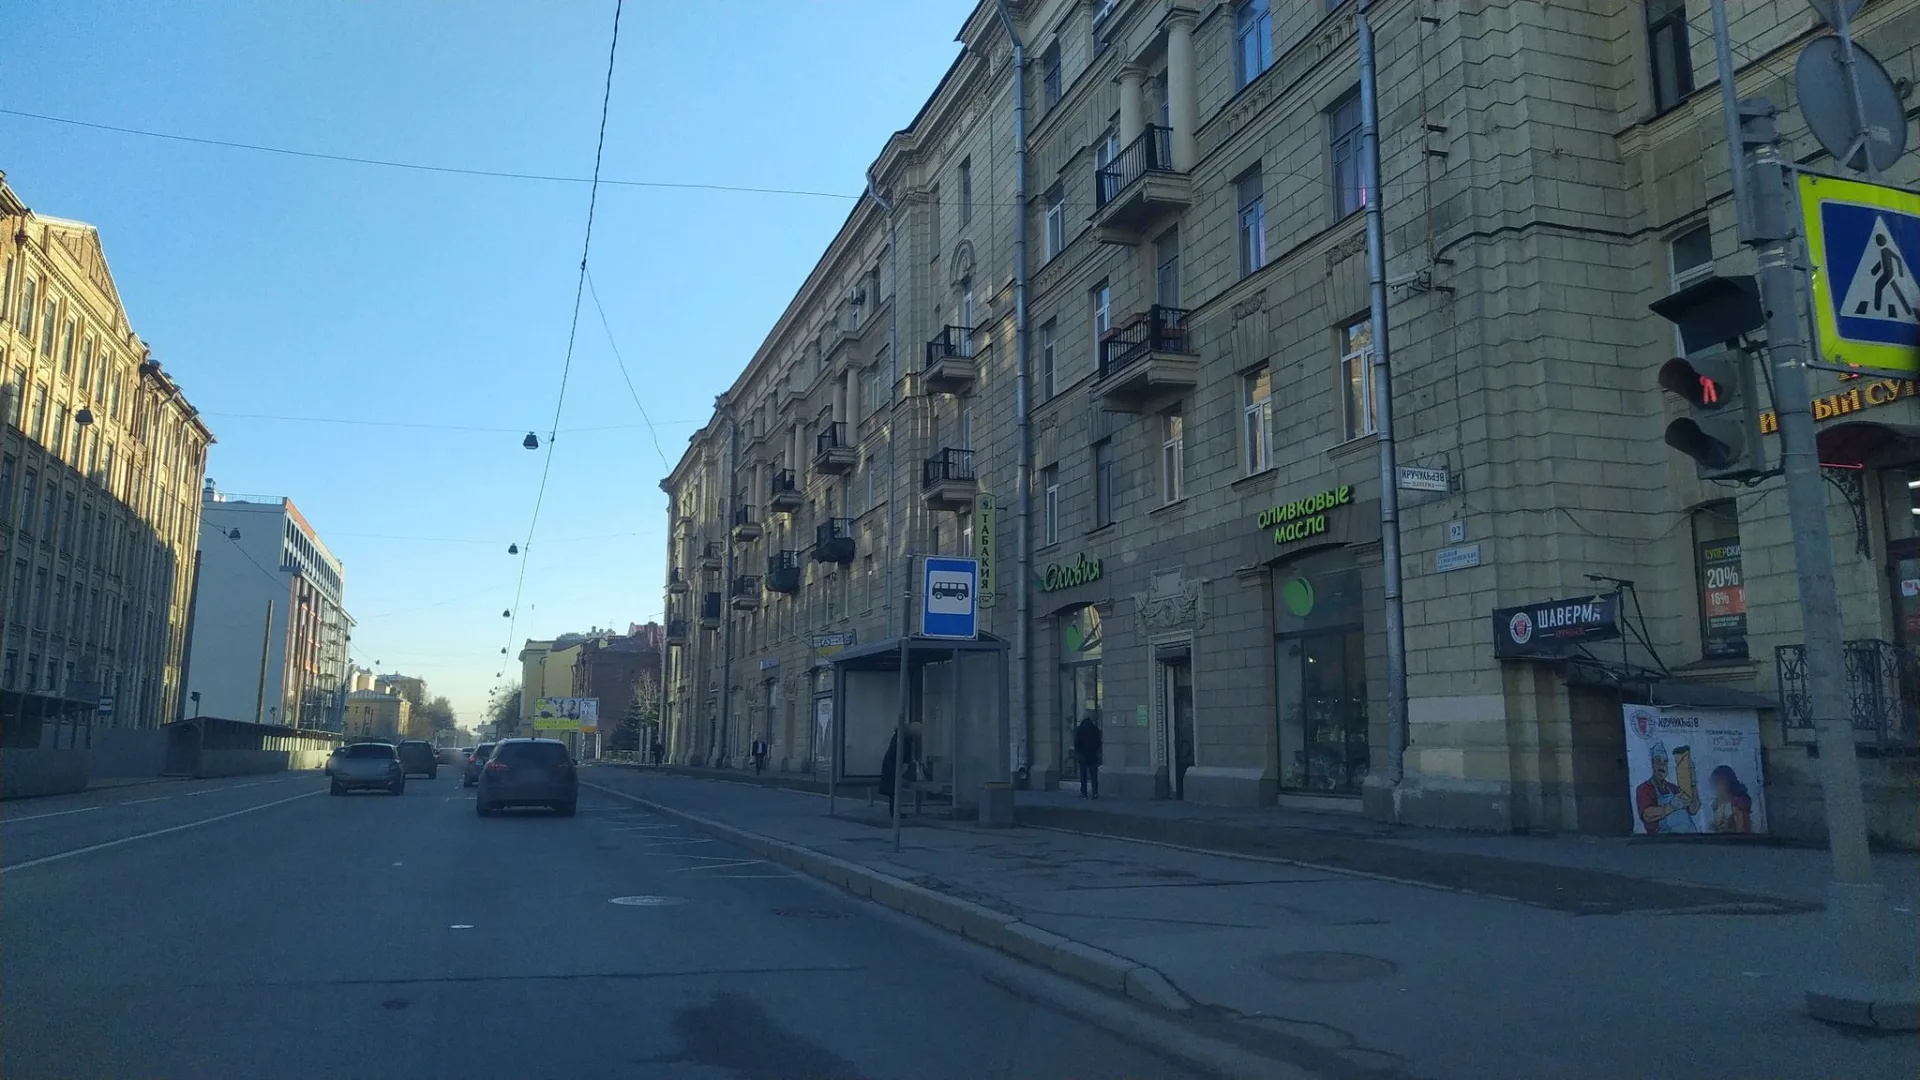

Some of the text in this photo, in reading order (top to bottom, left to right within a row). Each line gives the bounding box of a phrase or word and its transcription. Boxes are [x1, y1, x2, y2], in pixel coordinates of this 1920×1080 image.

[1452, 526, 1461, 536] 92
[980, 514, 990, 590] ТАБАКИЯ
[1043, 552, 1101, 592] Оливия
[1707, 566, 1739, 589] 20%
